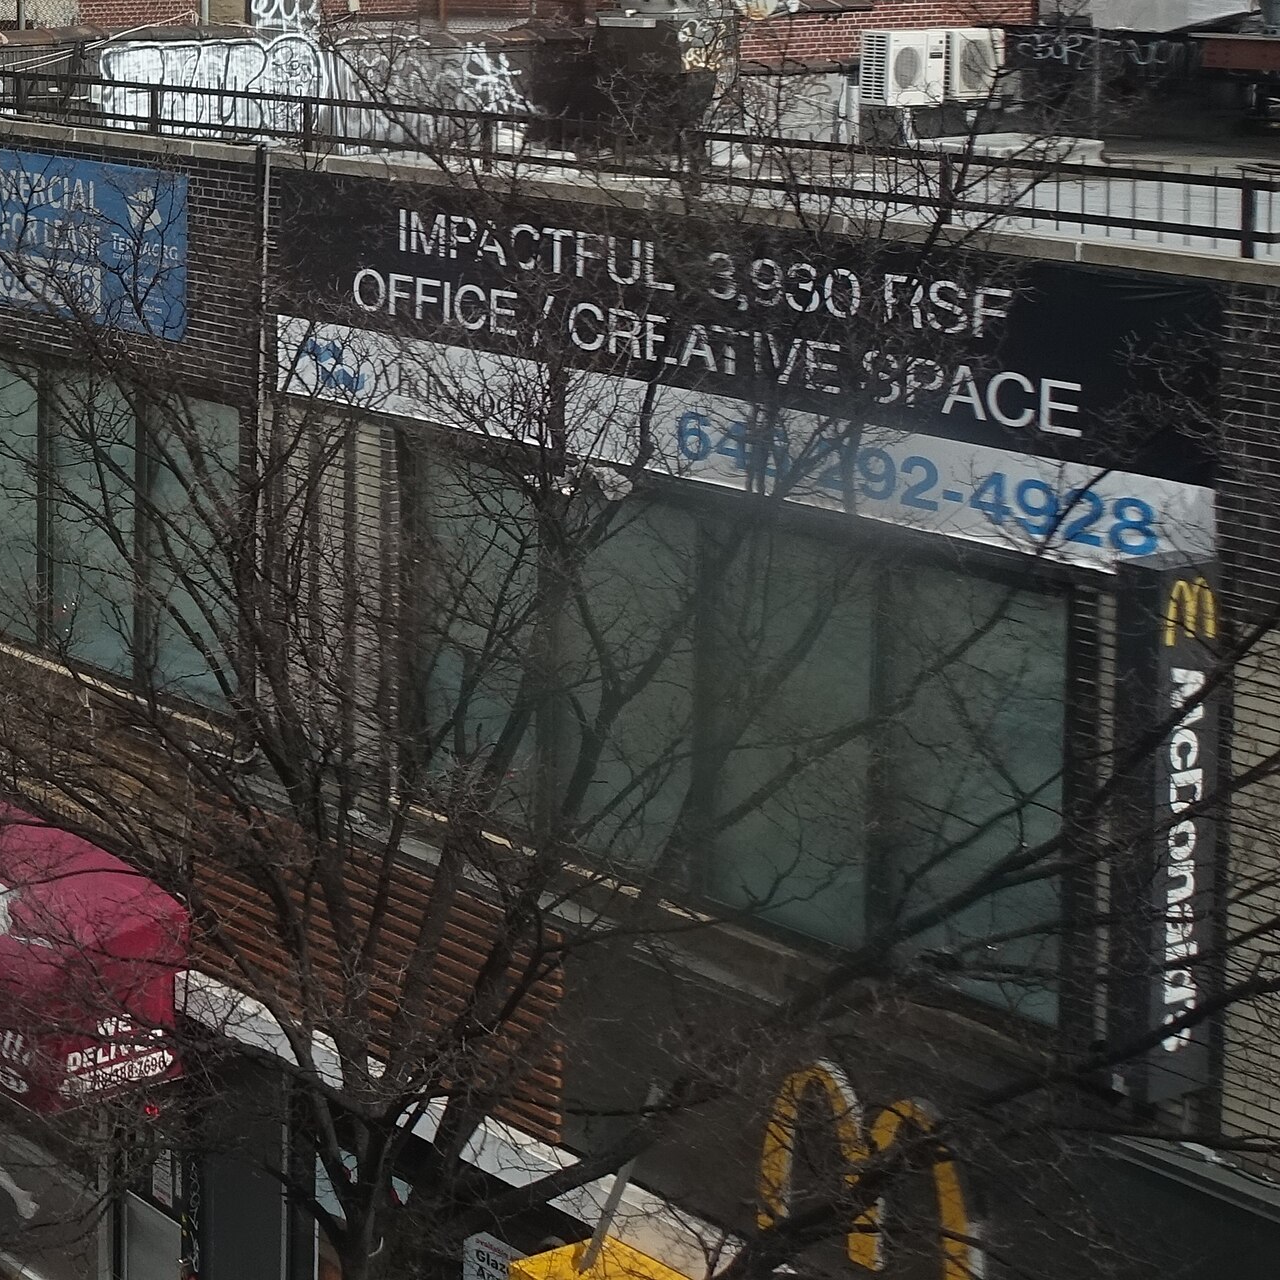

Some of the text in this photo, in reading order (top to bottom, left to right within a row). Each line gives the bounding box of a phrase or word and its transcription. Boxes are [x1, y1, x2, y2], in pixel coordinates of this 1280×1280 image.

[398, 208, 1013, 338] IMPACTFUL 3,930 RSF
[353, 267, 518, 337] OFFICE
[568, 302, 841, 394] CREATIVE
[860, 348, 1083, 438] SPACE
[96, 1013, 132, 1036] WE
